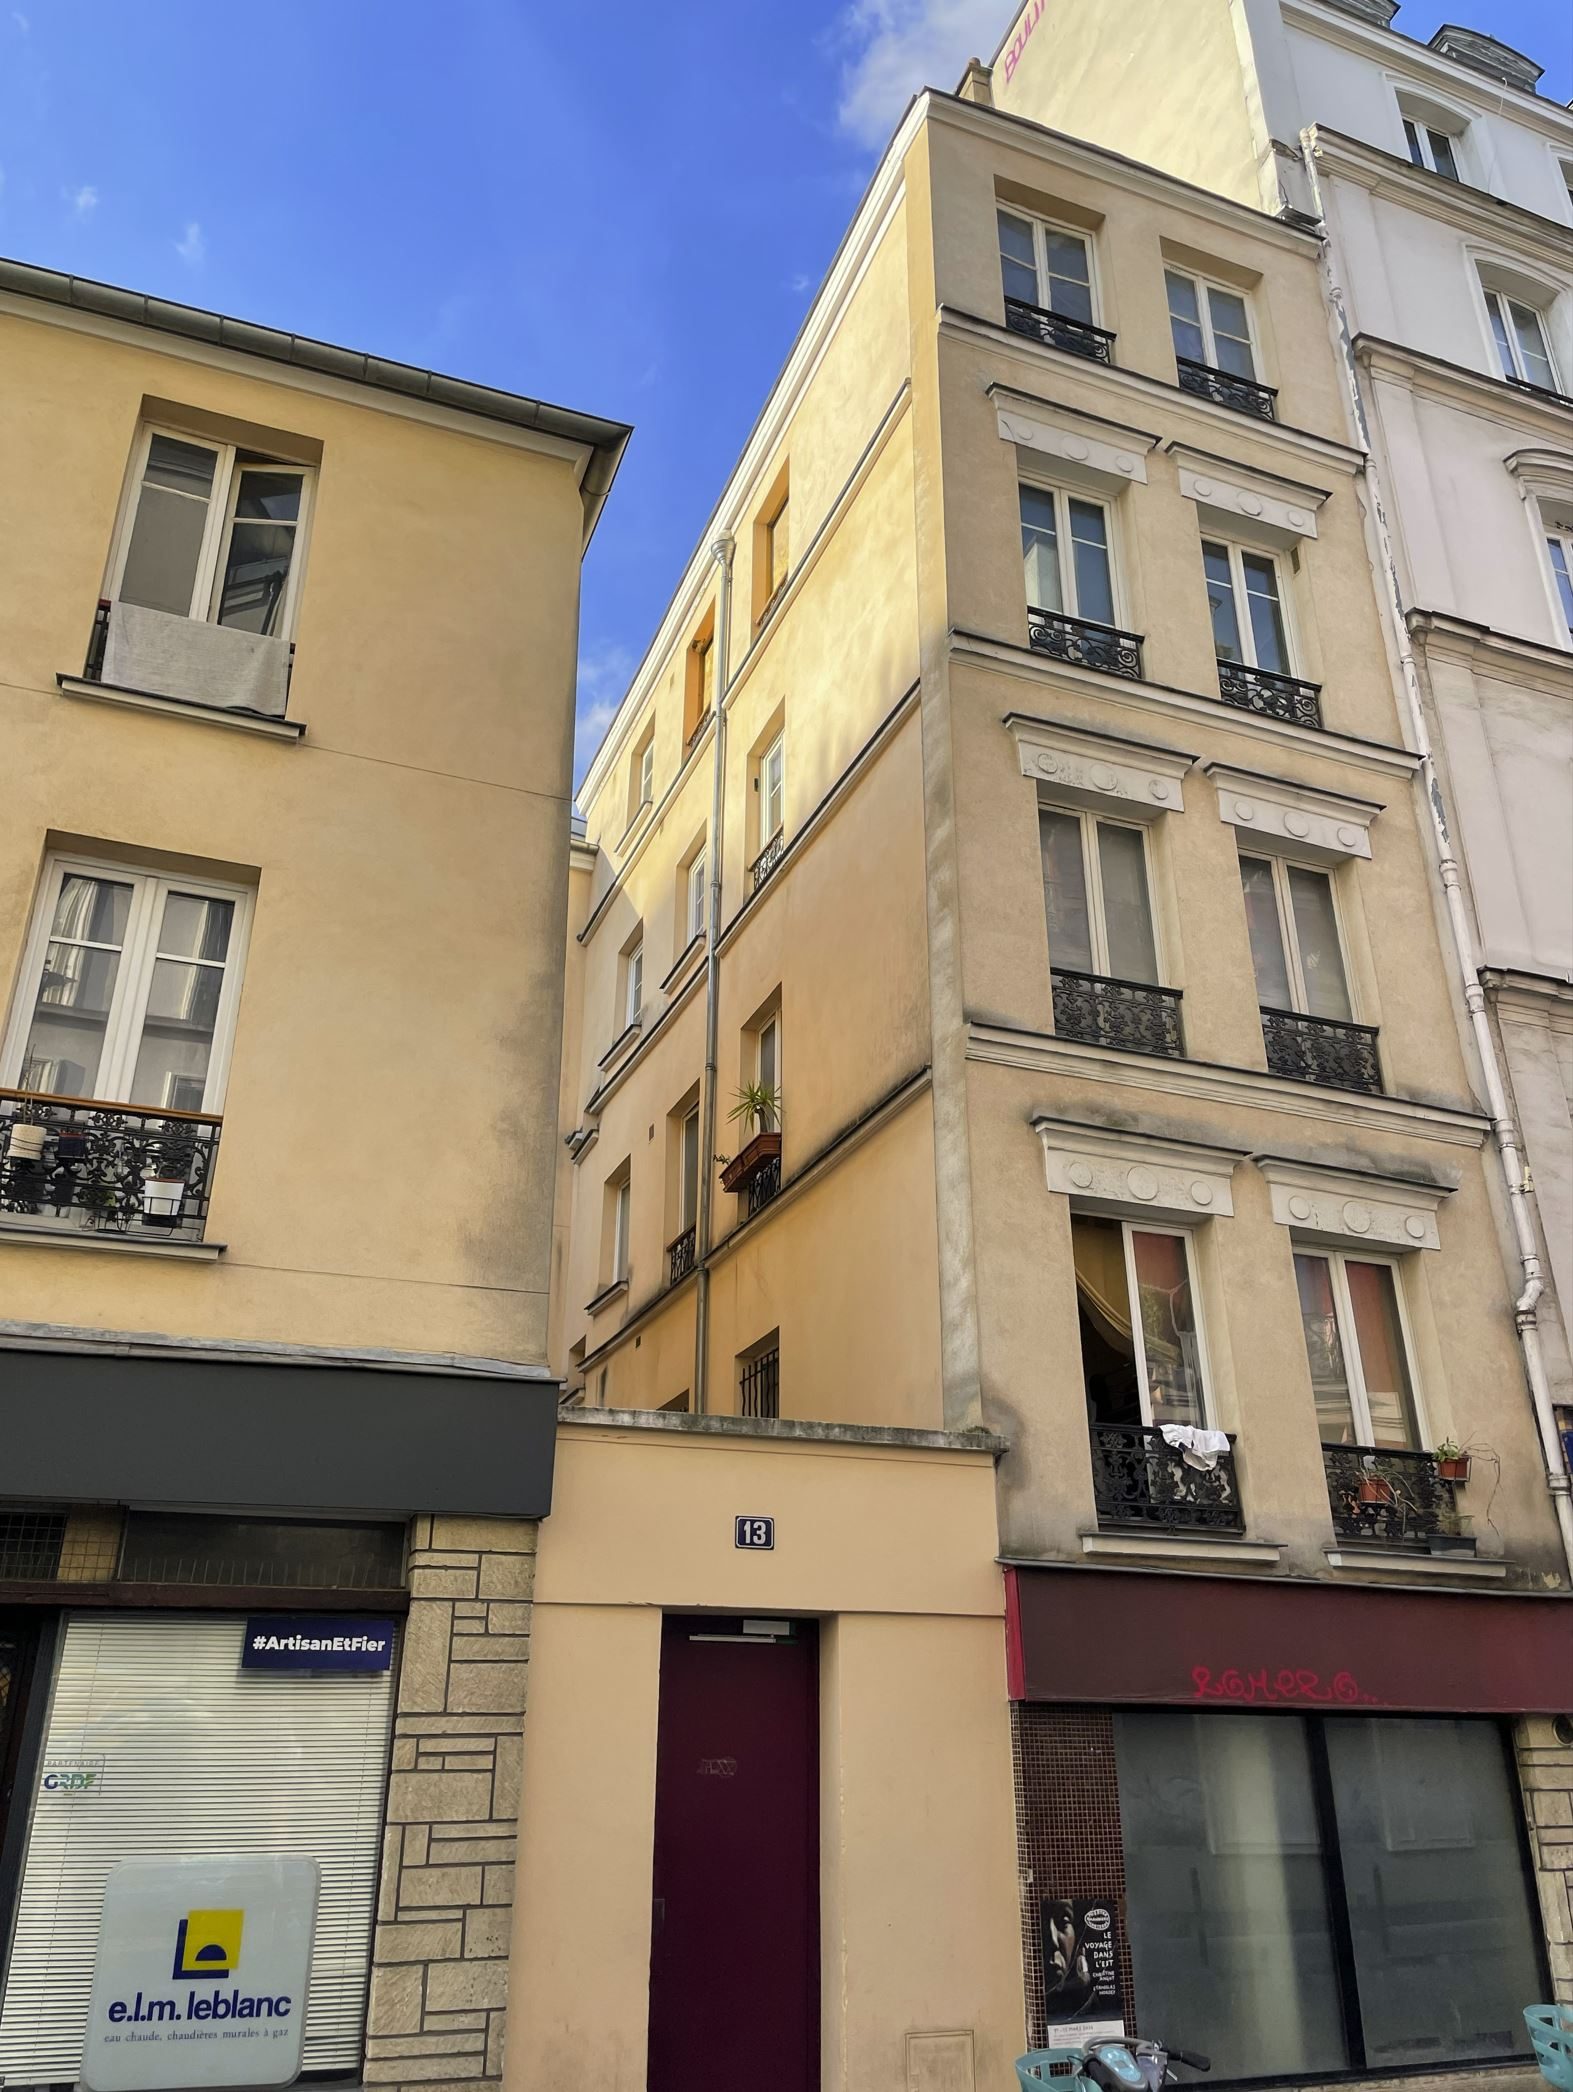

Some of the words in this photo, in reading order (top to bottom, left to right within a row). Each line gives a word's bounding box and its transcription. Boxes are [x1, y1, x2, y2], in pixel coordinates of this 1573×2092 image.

[744, 1520, 766, 1544] 13
[252, 1635, 385, 1652] #ArtisanEtFier
[1103, 1931, 1112, 1939] LE
[1085, 1941, 1113, 1951] VOYAGE
[1093, 1951, 1114, 1959] DANS
[108, 1992, 181, 2022] e.l.m.
[187, 1989, 292, 2020] leblanc
[104, 2035, 121, 2043] eau
[167, 2029, 218, 2041] chaudières
[222, 2027, 260, 2038] murales
[263, 2026, 269, 2037] à
[272, 2028, 289, 2039] gaz
